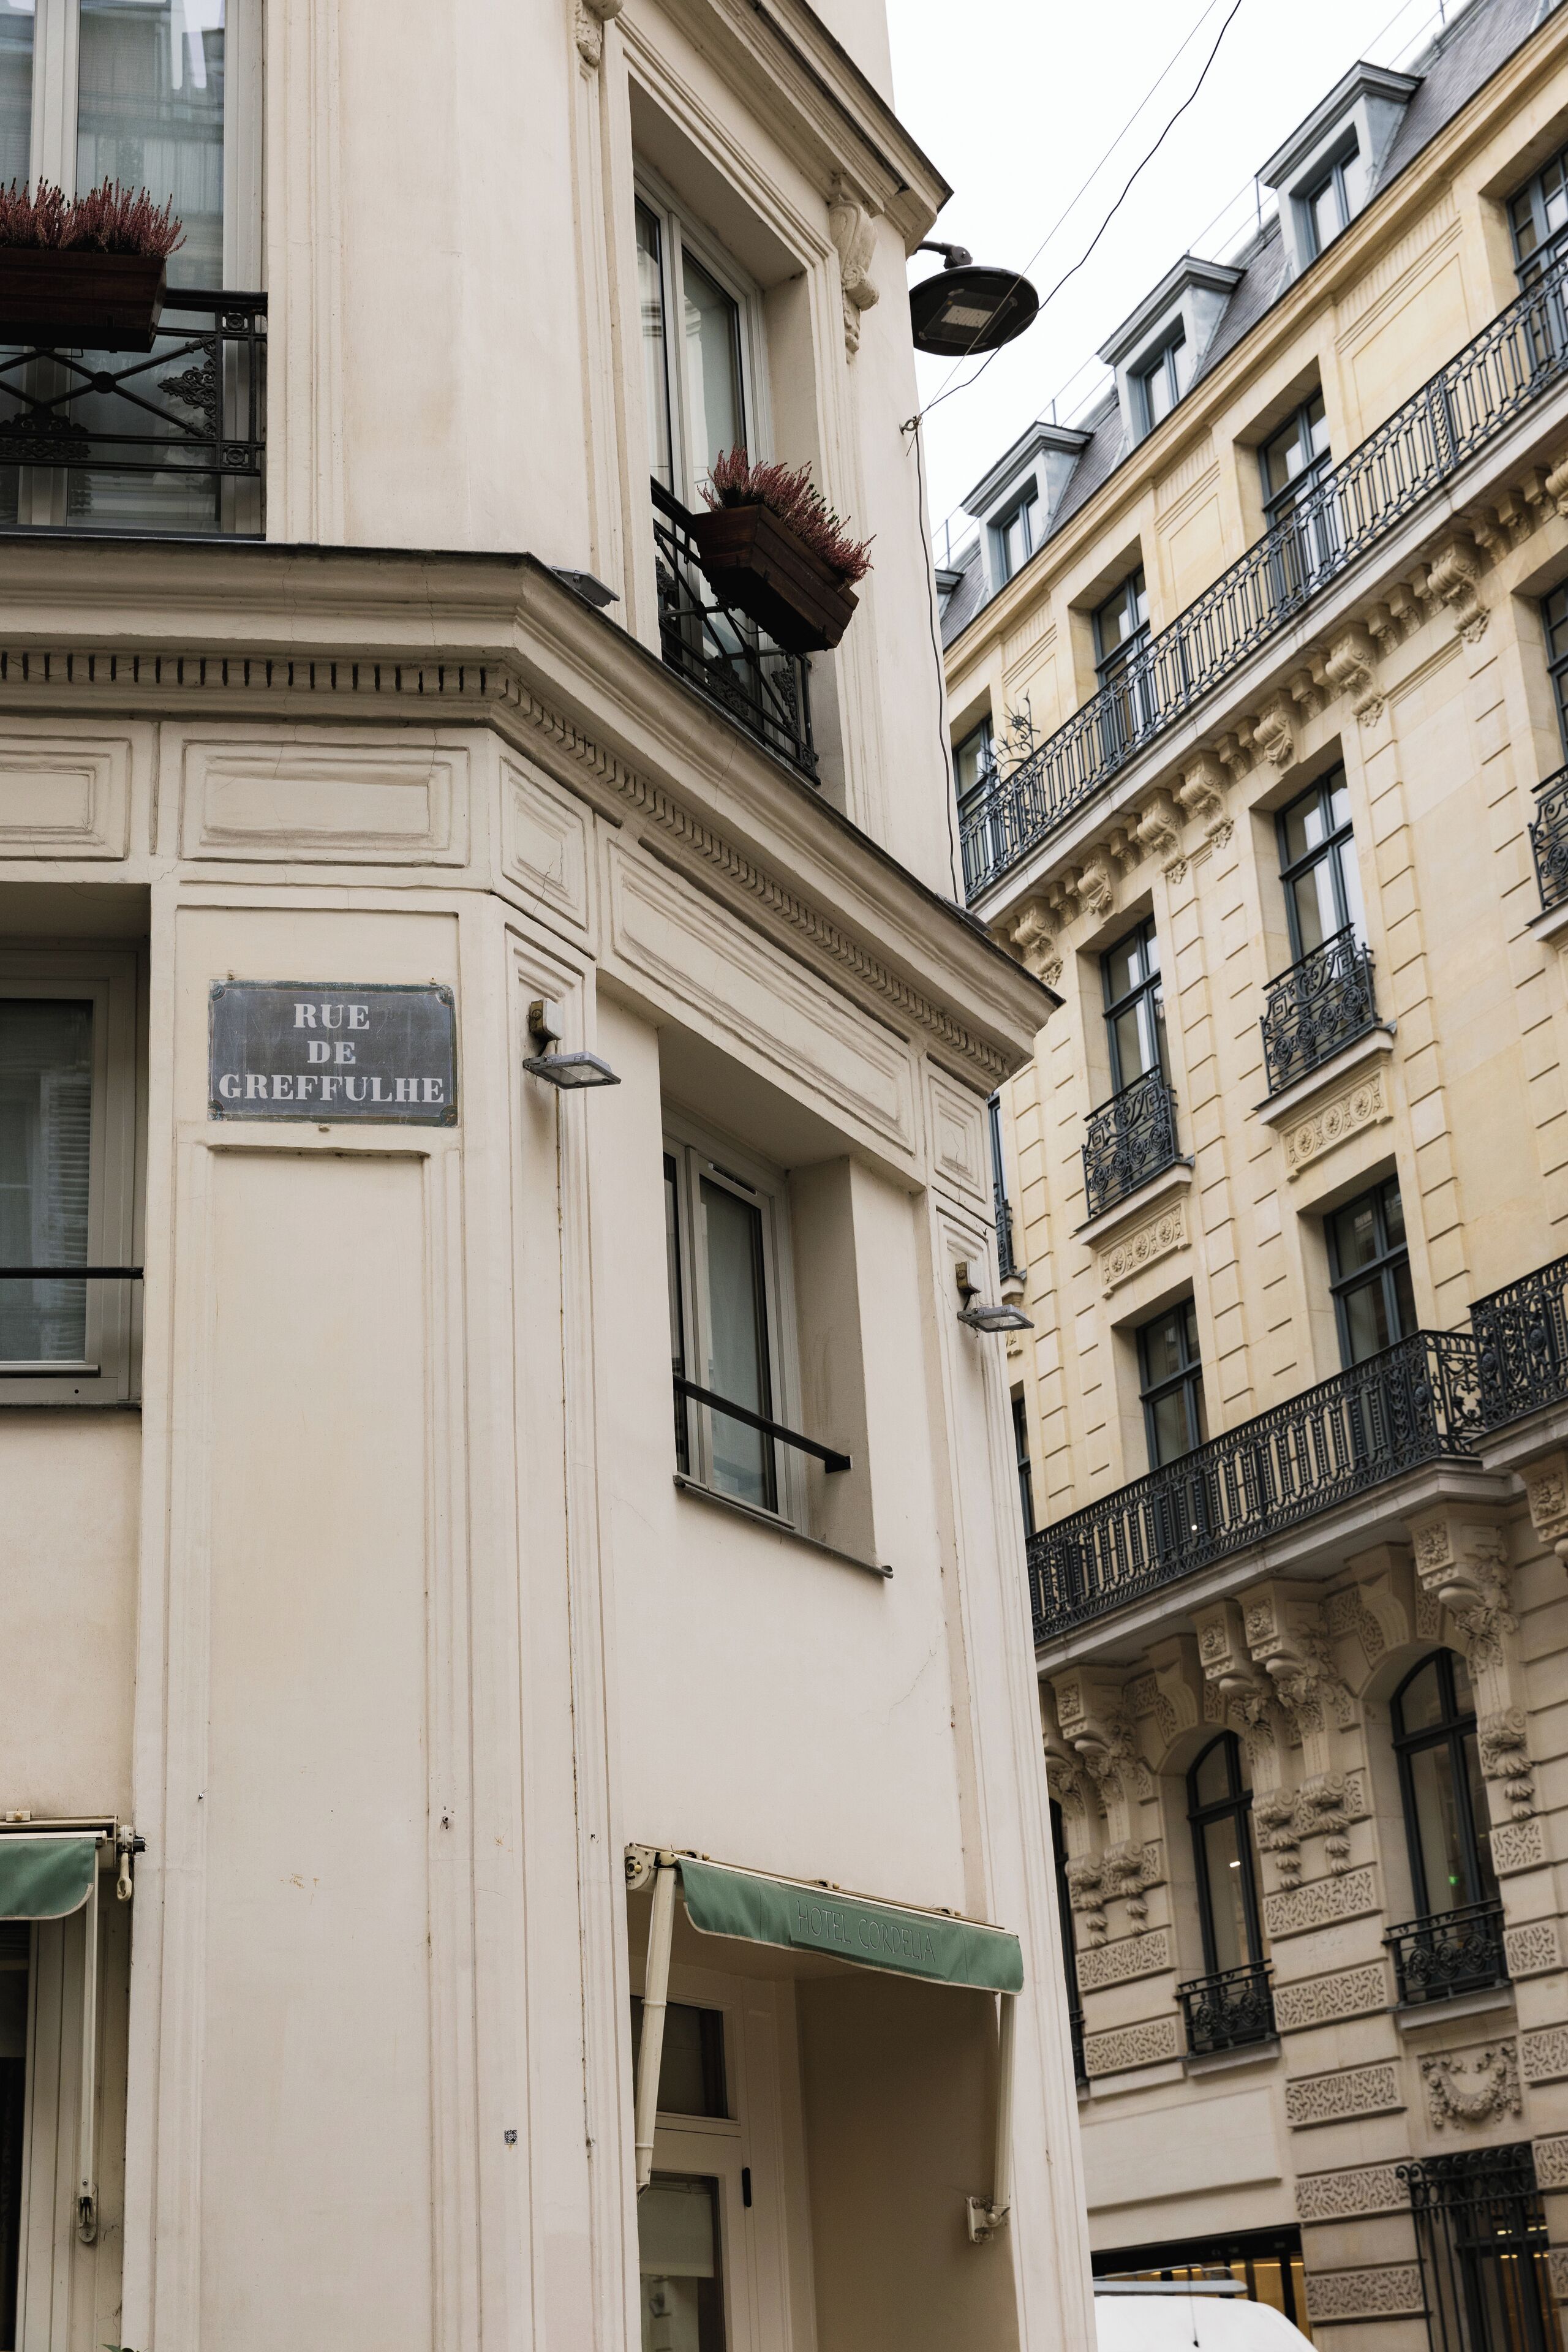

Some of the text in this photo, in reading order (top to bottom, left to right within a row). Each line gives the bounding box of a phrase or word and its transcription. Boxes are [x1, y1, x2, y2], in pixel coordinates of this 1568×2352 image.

[293, 1003, 369, 1029] RUE
[307, 1041, 356, 1064] DE
[219, 1074, 444, 1102] GREFFULHE
[797, 1900, 935, 1962] HOTEL CORDELIA
